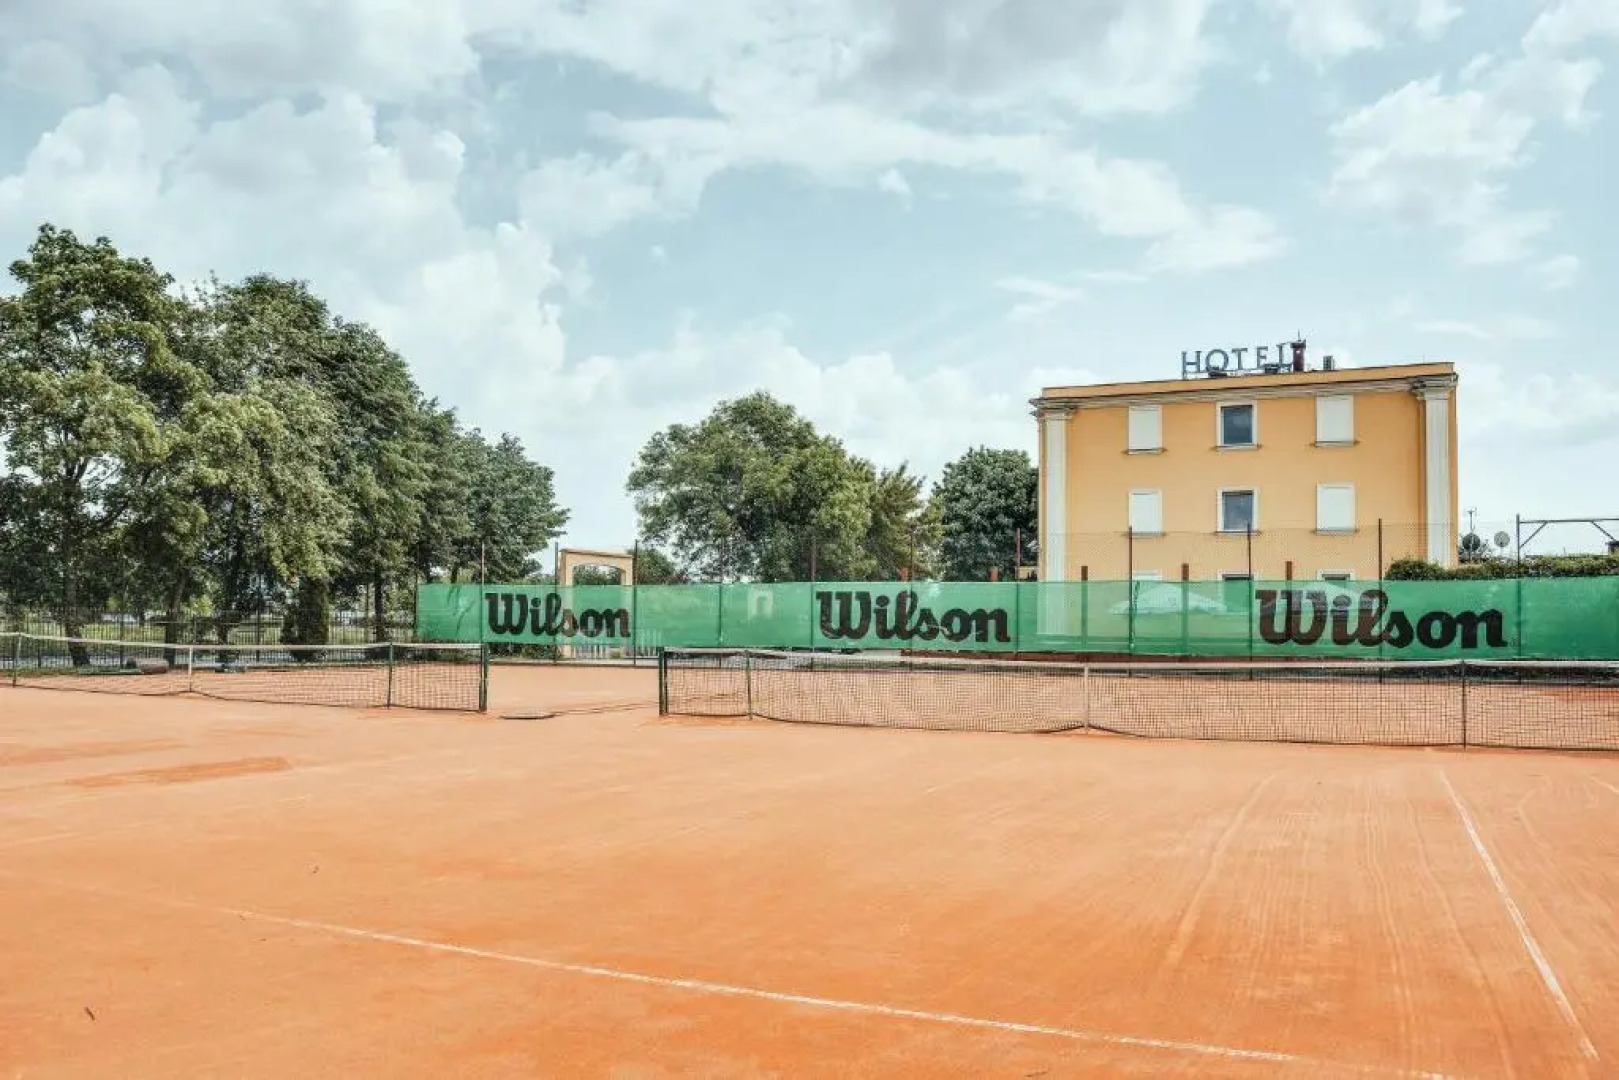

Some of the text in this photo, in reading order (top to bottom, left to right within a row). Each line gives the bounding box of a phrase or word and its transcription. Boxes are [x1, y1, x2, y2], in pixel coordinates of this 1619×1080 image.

[1181, 344, 1293, 374] HOTEL
[485, 593, 631, 638] Wilson
[815, 590, 1011, 643] Wilson
[1255, 589, 1507, 649] Wilson
